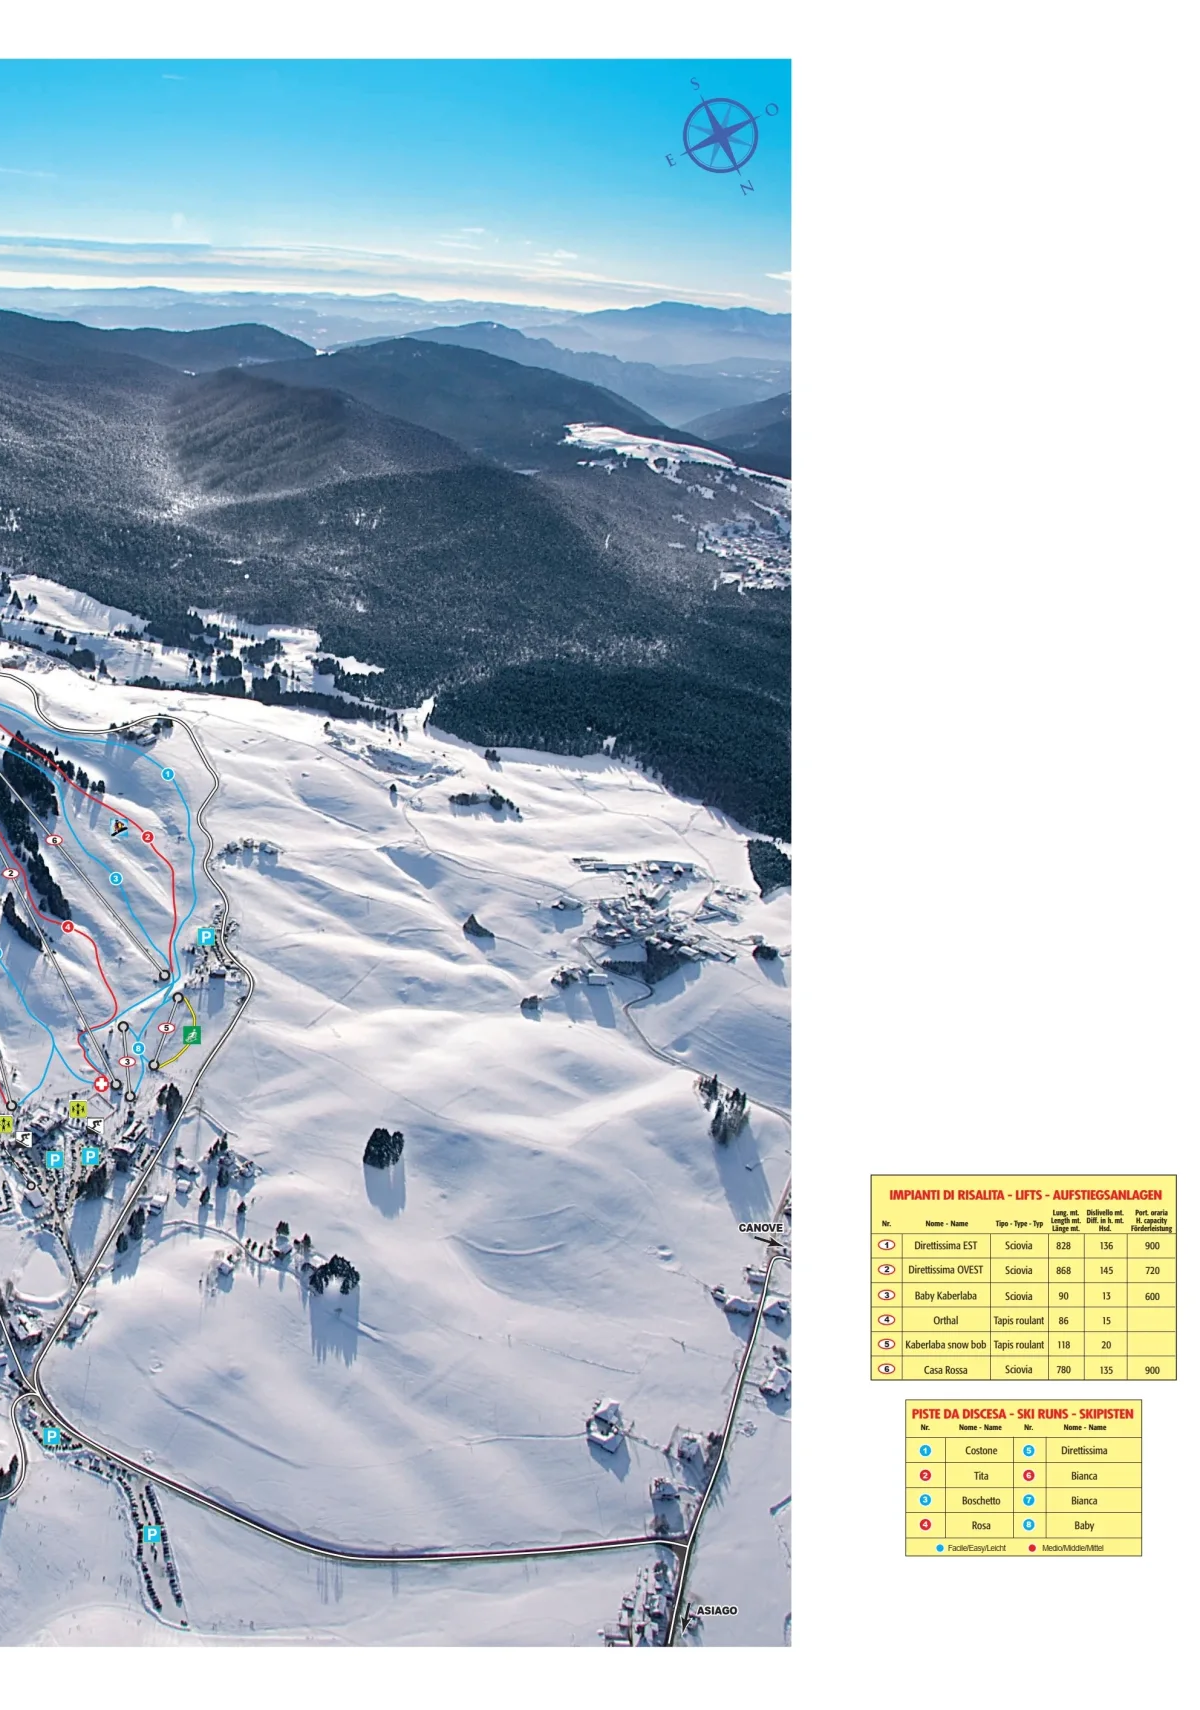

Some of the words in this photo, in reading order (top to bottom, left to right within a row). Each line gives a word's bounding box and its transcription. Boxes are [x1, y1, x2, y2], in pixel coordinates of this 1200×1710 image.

[690, 76, 700, 91] S
[765, 102, 779, 116] O
[665, 153, 677, 167] E
[740, 179, 755, 196] N
[890, 1190, 940, 1200] IMPIANTI
[943, 1190, 954, 1200] DI
[958, 1190, 1005, 1200] RISALITA
[1015, 1190, 1042, 1200] LIFTS
[1052, 1190, 1162, 1200] AUFSTIEGSANLAGEN
[738, 1223, 783, 1233] CANOVE
[996, 1220, 1008, 1228] Tipo
[1014, 1220, 1027, 1228] Type
[1033, 1220, 1043, 1228] Typ
[1131, 1225, 1172, 1233] Förderleistung
[914, 1241, 961, 1250] Direttissima
[963, 1241, 978, 1250] EST
[1005, 1241, 1033, 1250] Sciovia
[1056, 1242, 1071, 1250] 828
[1100, 1242, 1113, 1250] 136
[1145, 1242, 1160, 1250] 900
[908, 1265, 955, 1274] Direttissima
[957, 1265, 983, 1274] OVEST
[1005, 1266, 1033, 1275] Sciovia
[1056, 1266, 1071, 1274] 868
[1100, 1266, 1113, 1274] 145
[1145, 1266, 1160, 1274] 720
[915, 1291, 935, 1302] Baby
[937, 1291, 977, 1300] Kaberlaba
[1005, 1292, 1033, 1301] Sciovia
[1059, 1292, 1069, 1300] 90
[1103, 1292, 1111, 1300] 13
[1145, 1292, 1160, 1301] 600
[933, 1316, 959, 1325] Orthal
[993, 1316, 1014, 1327] Tapis
[1015, 1316, 1044, 1325] roulant
[1059, 1317, 1069, 1325] 86
[1103, 1317, 1111, 1325] 15
[905, 1340, 946, 1349] Kaberlaba
[971, 1340, 986, 1349] bob
[993, 1340, 1014, 1351] Tapis
[1015, 1340, 1044, 1349] roulant
[1058, 1341, 1070, 1349] 118
[1101, 1341, 1111, 1349] 20
[924, 1365, 943, 1375] Casa
[945, 1365, 968, 1375] Rossa
[1005, 1365, 1033, 1374] Sciovia
[1057, 1366, 1071, 1374] 780
[1100, 1366, 1113, 1374] 135
[1145, 1366, 1160, 1374] 900
[912, 1409, 940, 1419] PISTE
[944, 1409, 959, 1419] DA
[963, 1409, 1006, 1420] DISCESA
[1017, 1409, 1034, 1419] SKI
[1038, 1409, 1068, 1419] RUNS
[1079, 1409, 1133, 1420] SKIPISTEN
[965, 1446, 998, 1455] Costone
[1061, 1446, 1108, 1455] Direttissima
[974, 1471, 989, 1480] Tita
[1071, 1471, 1097, 1480] Bianca
[962, 1496, 1001, 1505] Boschetto
[1071, 1496, 1097, 1505] Bianca
[972, 1521, 991, 1530] Rosa
[1075, 1520, 1094, 1532] Baby
[697, 1606, 738, 1615] ASIAGO
